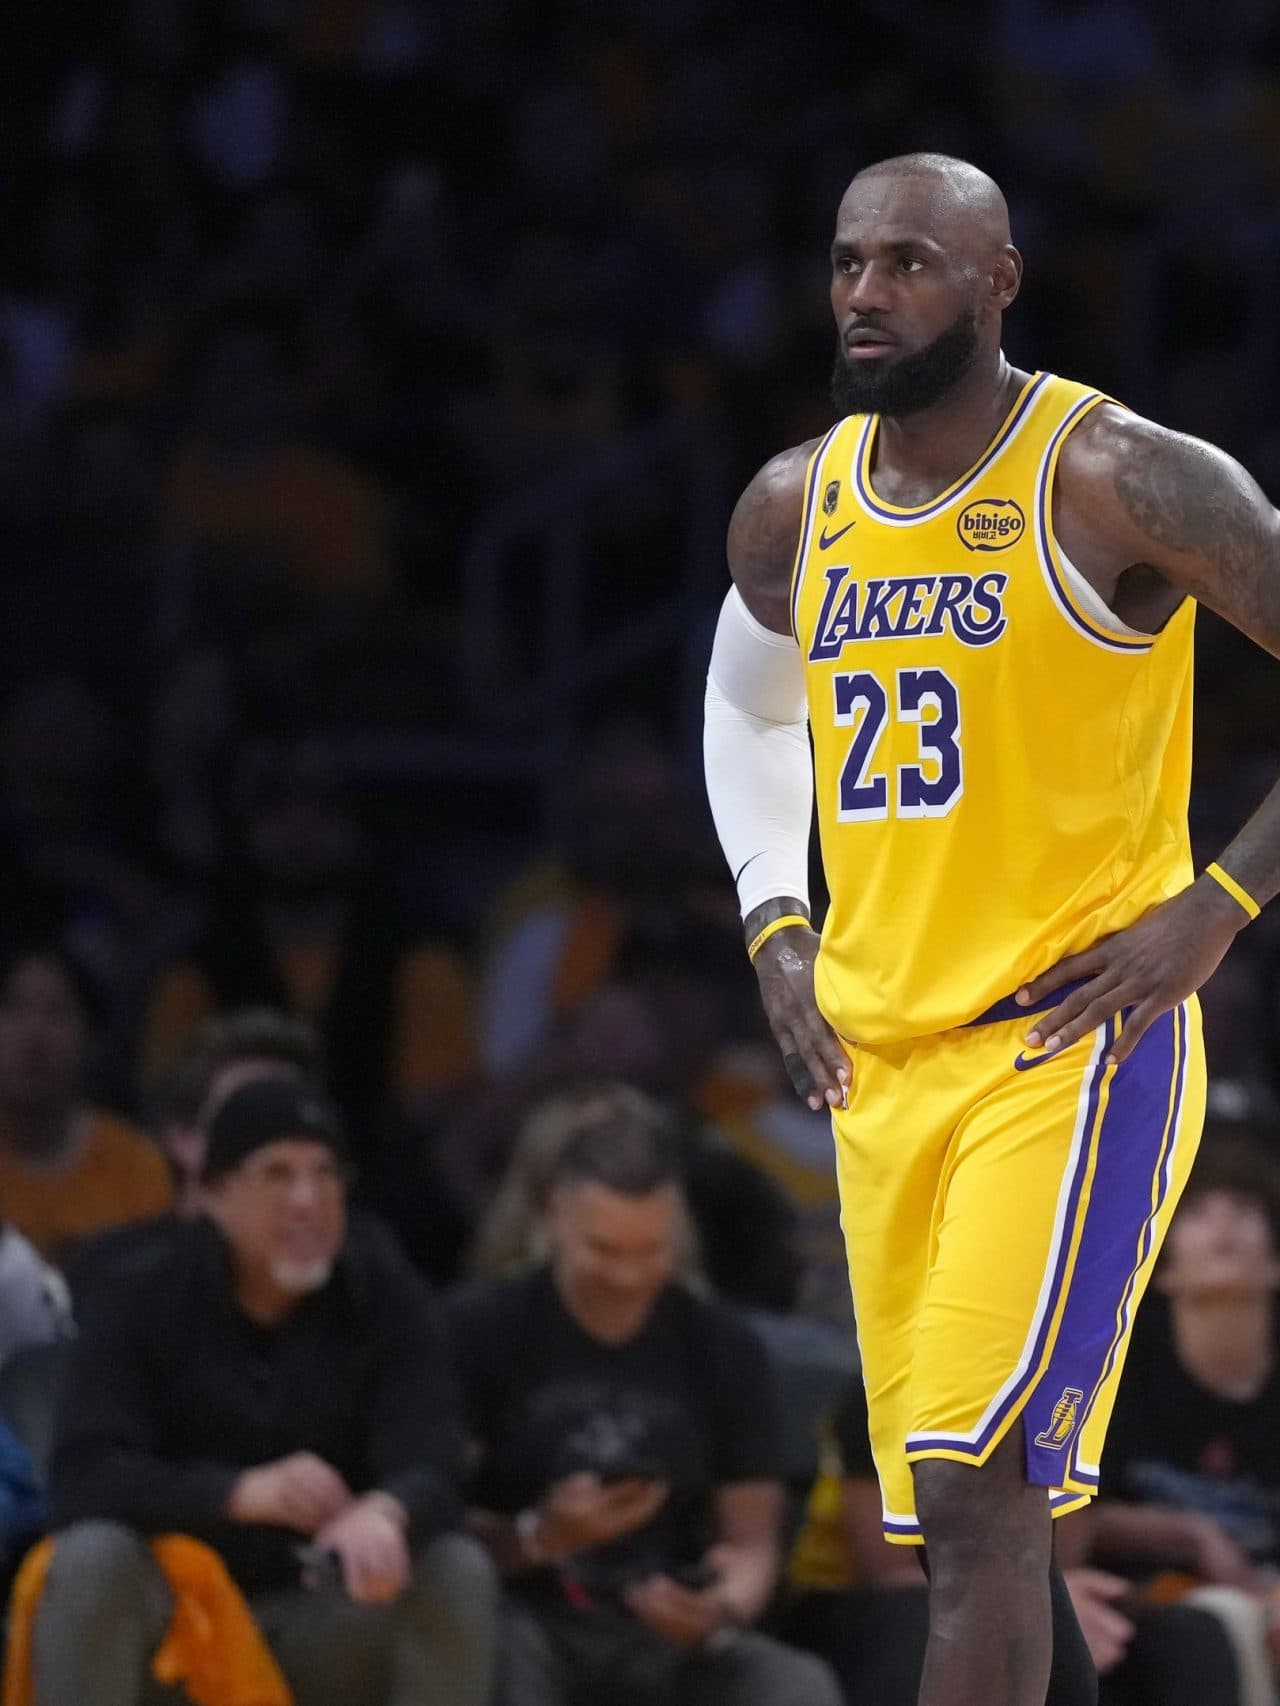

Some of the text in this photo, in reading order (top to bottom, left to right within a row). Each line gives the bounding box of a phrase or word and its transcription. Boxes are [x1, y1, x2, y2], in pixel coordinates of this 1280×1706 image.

[964, 513, 1021, 536] bibigo
[808, 566, 1008, 662] LAKERS
[833, 668, 963, 823] 23
